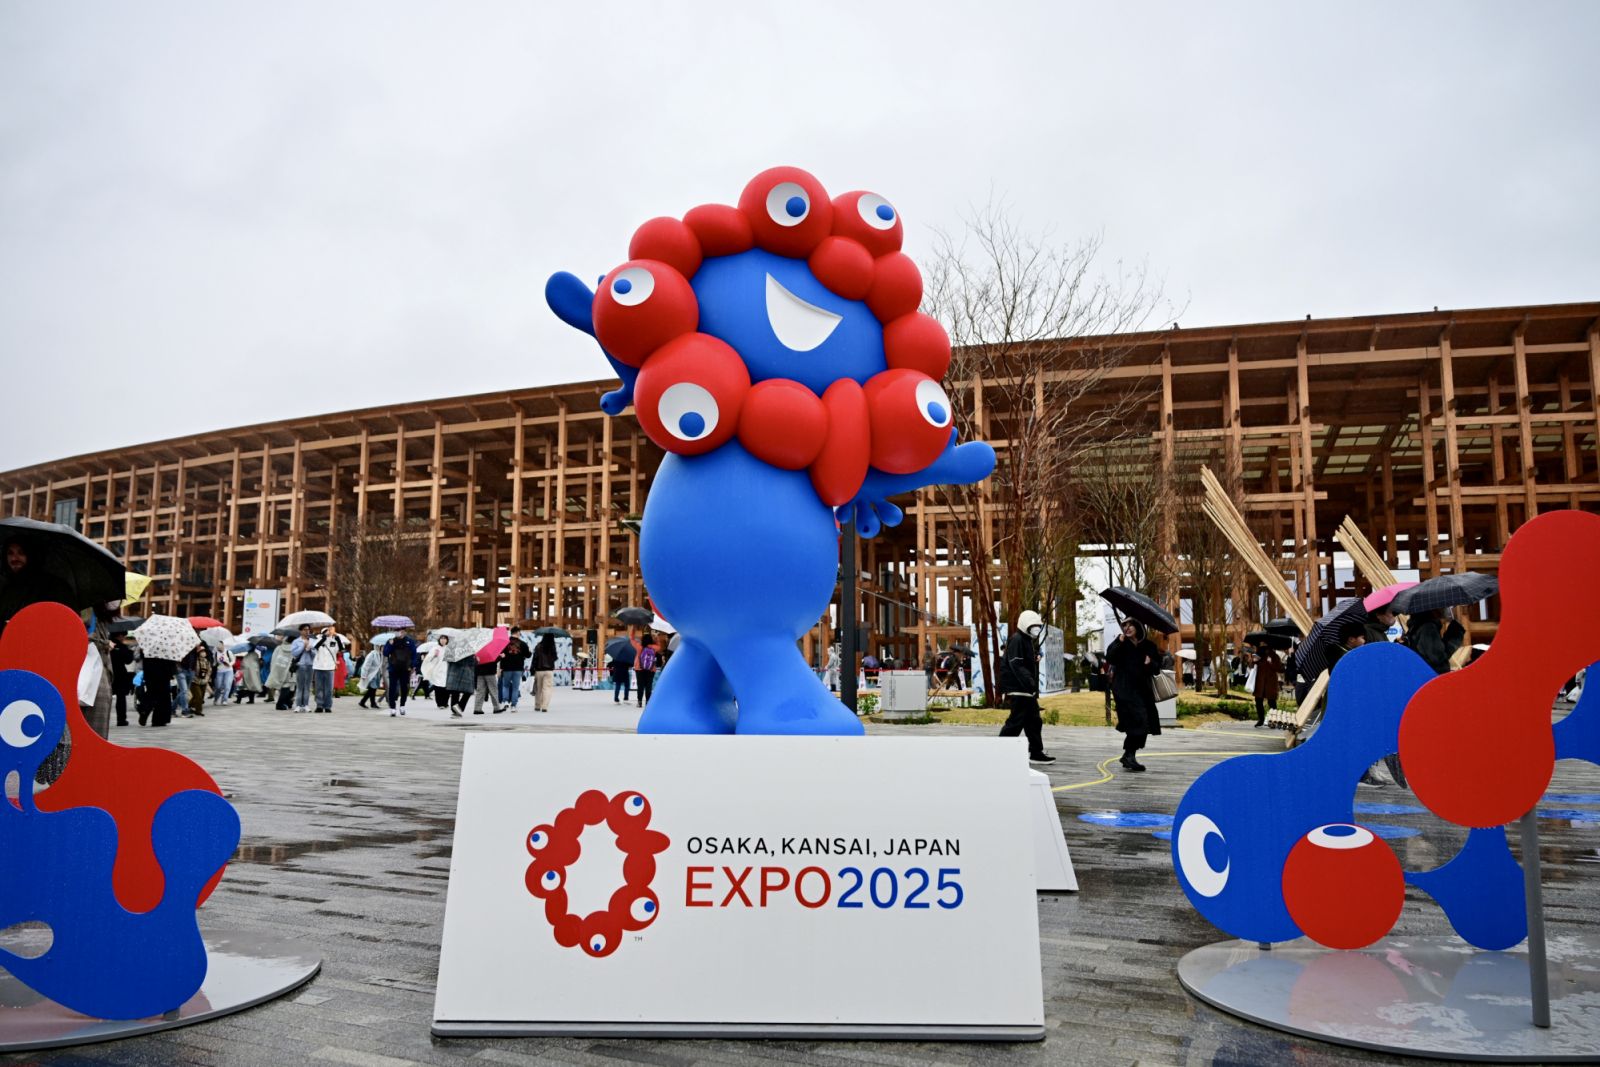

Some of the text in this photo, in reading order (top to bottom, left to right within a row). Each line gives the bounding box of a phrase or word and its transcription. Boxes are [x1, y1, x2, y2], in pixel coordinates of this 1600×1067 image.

[687, 836, 961, 858] OSAKA, KANSAI, JAPAN
[685, 866, 964, 909] EXPO2025
